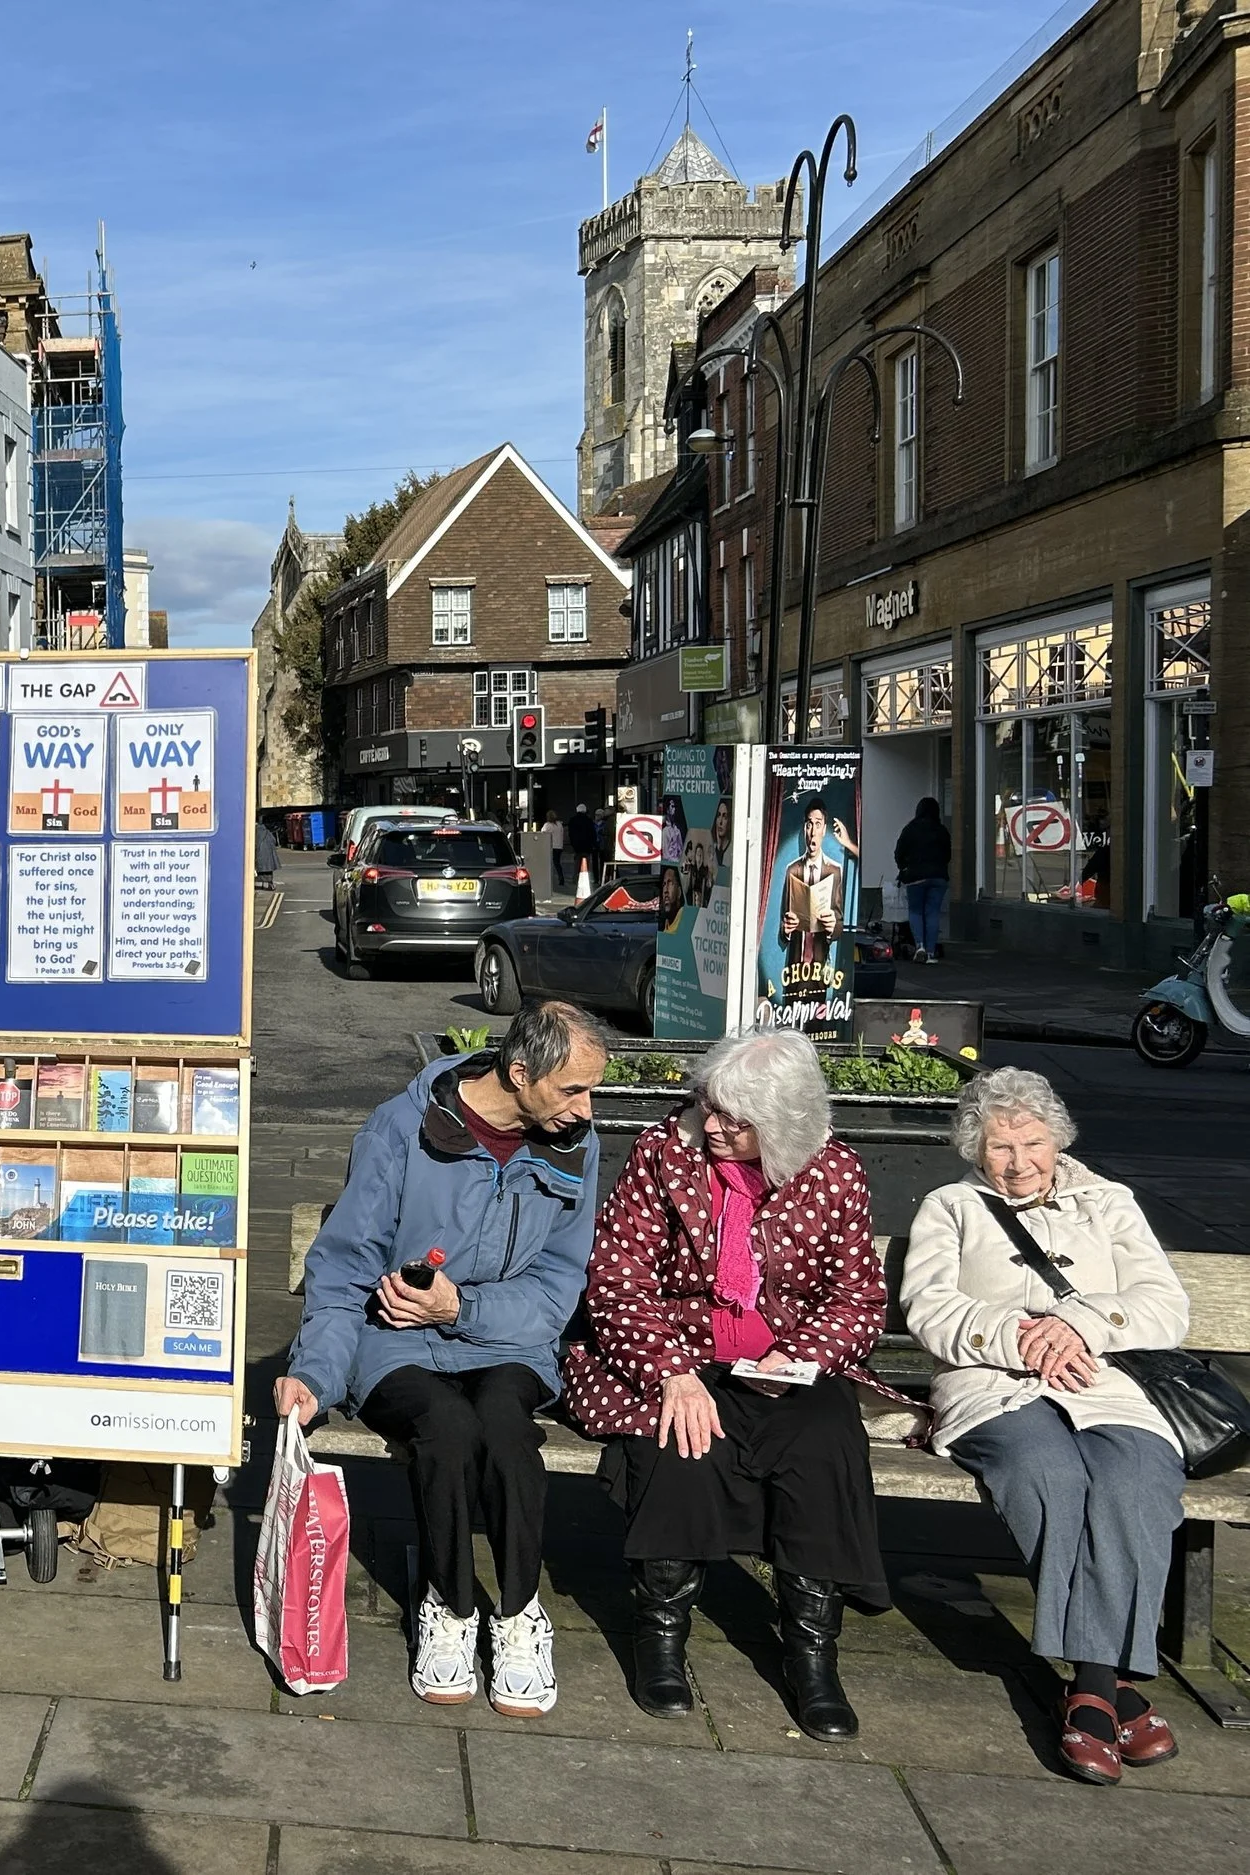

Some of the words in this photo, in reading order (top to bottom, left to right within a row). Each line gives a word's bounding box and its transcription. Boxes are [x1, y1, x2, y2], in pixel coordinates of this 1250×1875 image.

[866, 580, 914, 630] Magnet
[21, 684, 53, 698] THE
[60, 684, 95, 698] GAP
[37, 726, 80, 737] GOD's
[146, 724, 184, 736] ONLY
[23, 742, 94, 769] WAY
[129, 740, 201, 768] WAY
[667, 749, 694, 762] COMING
[696, 750, 706, 761] TO
[667, 765, 706, 778] SALISBURY
[772, 764, 856, 779] "Heart-breakingly
[666, 780, 684, 792] ARTS
[686, 780, 715, 794] CENTRE
[798, 778, 828, 792] funny"
[124, 806, 145, 815] Man
[183, 804, 207, 814] God
[155, 817, 172, 826] Sin
[40, 853, 71, 862] Christ
[75, 853, 97, 862] also
[19, 867, 63, 876] suffered
[68, 868, 94, 876] once
[36, 882, 51, 891] for
[54, 883, 78, 892] sins,
[26, 896, 44, 905] the
[48, 896, 67, 908] just
[71, 896, 86, 905] for
[714, 901, 729, 915] GET
[28, 911, 46, 920] the
[50, 911, 84, 922] unjust,
[18, 925, 39, 935] that
[44, 926, 58, 935] He
[63, 925, 94, 937] might
[706, 919, 728, 936] YOUR
[34, 940, 62, 951] bring
[67, 941, 78, 949] us
[695, 936, 727, 957] TICKETS
[36, 955, 46, 964] to
[50, 955, 75, 964] God'
[661, 957, 679, 969] MUSIC
[703, 958, 727, 976] NOW!
[781, 962, 844, 989] CHORUS
[768, 980, 776, 997] A
[799, 989, 807, 997] of
[195, 1158, 234, 1171] ULTIMATE
[188, 1170, 234, 1183] QUESTIONS
[12, 1220, 35, 1230] JOHN
[95, 1208, 157, 1229] Please
[162, 1208, 214, 1231] take!
[95, 1282, 116, 1291] HOLY
[117, 1282, 137, 1292] BIBLE
[173, 1342, 196, 1351] SCAN
[199, 1344, 212, 1352] ME
[91, 1412, 216, 1432] oamission.com
[305, 1490, 326, 1658] WATERSTONES
